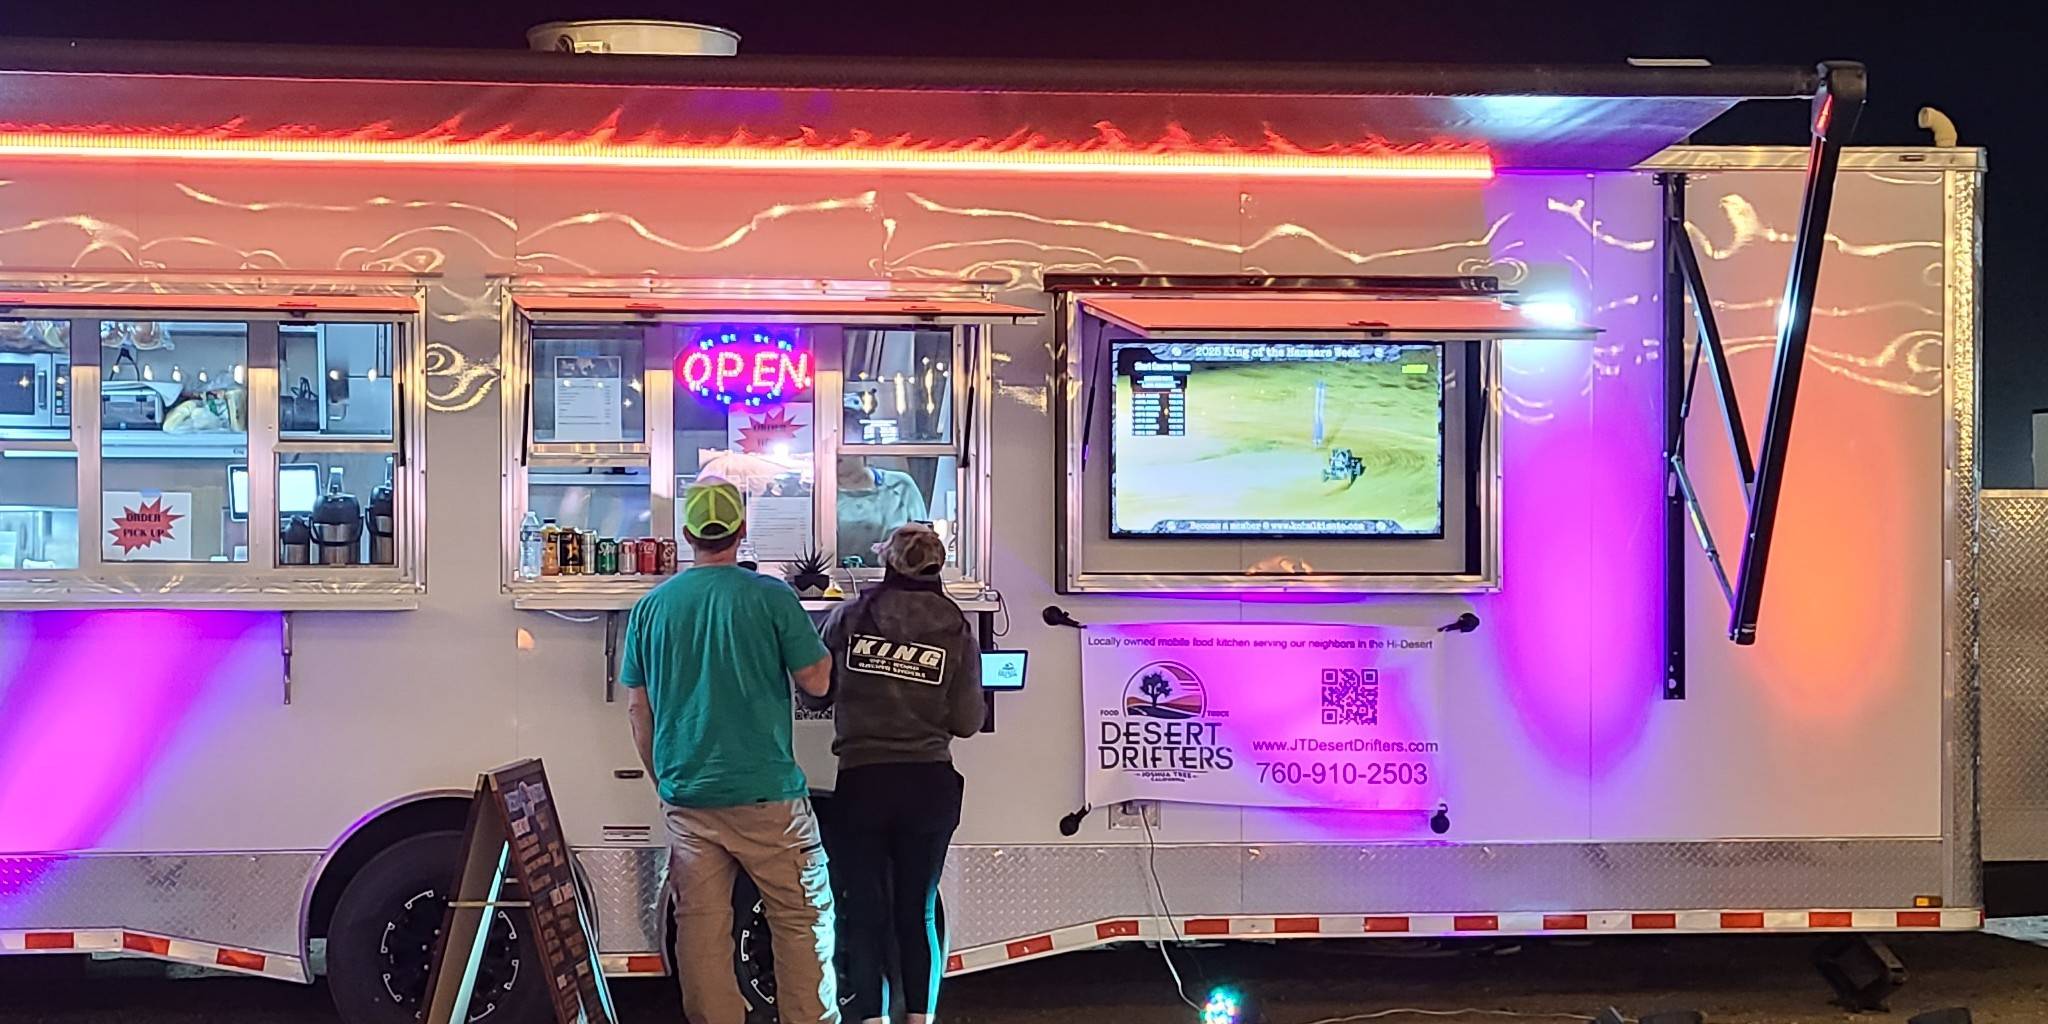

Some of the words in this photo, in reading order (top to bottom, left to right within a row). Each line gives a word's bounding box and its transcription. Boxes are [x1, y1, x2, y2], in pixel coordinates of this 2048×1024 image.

[1223, 346, 1250, 358] King
[1252, 346, 1264, 357] of
[1266, 346, 1285, 357] the
[1334, 346, 1361, 357] Week
[683, 351, 809, 393] OPEN
[126, 514, 161, 522] ORDER
[1190, 521, 1221, 531] Become
[123, 529, 147, 537] PICK
[151, 529, 164, 537] UP
[1088, 637, 1121, 647] Locally
[1124, 637, 1155, 646] owned
[1158, 637, 1190, 646] mobile
[1193, 637, 1213, 646] food
[1217, 638, 1250, 646] kitchen
[1254, 640, 1287, 649] serving
[1290, 640, 1305, 648] our
[1309, 639, 1355, 650] neighbors
[1358, 639, 1367, 648] in
[1369, 639, 1384, 648] the
[1387, 640, 1433, 649] Hi-Desert
[852, 639, 941, 667] KING
[1101, 721, 1222, 745] DESERT
[1253, 738, 1438, 752] www.JTDesertDrifters.com
[1098, 746, 1233, 769] DRIFTERS
[1174, 771, 1192, 779] TREE
[1256, 762, 1428, 785] 760-910-2503
